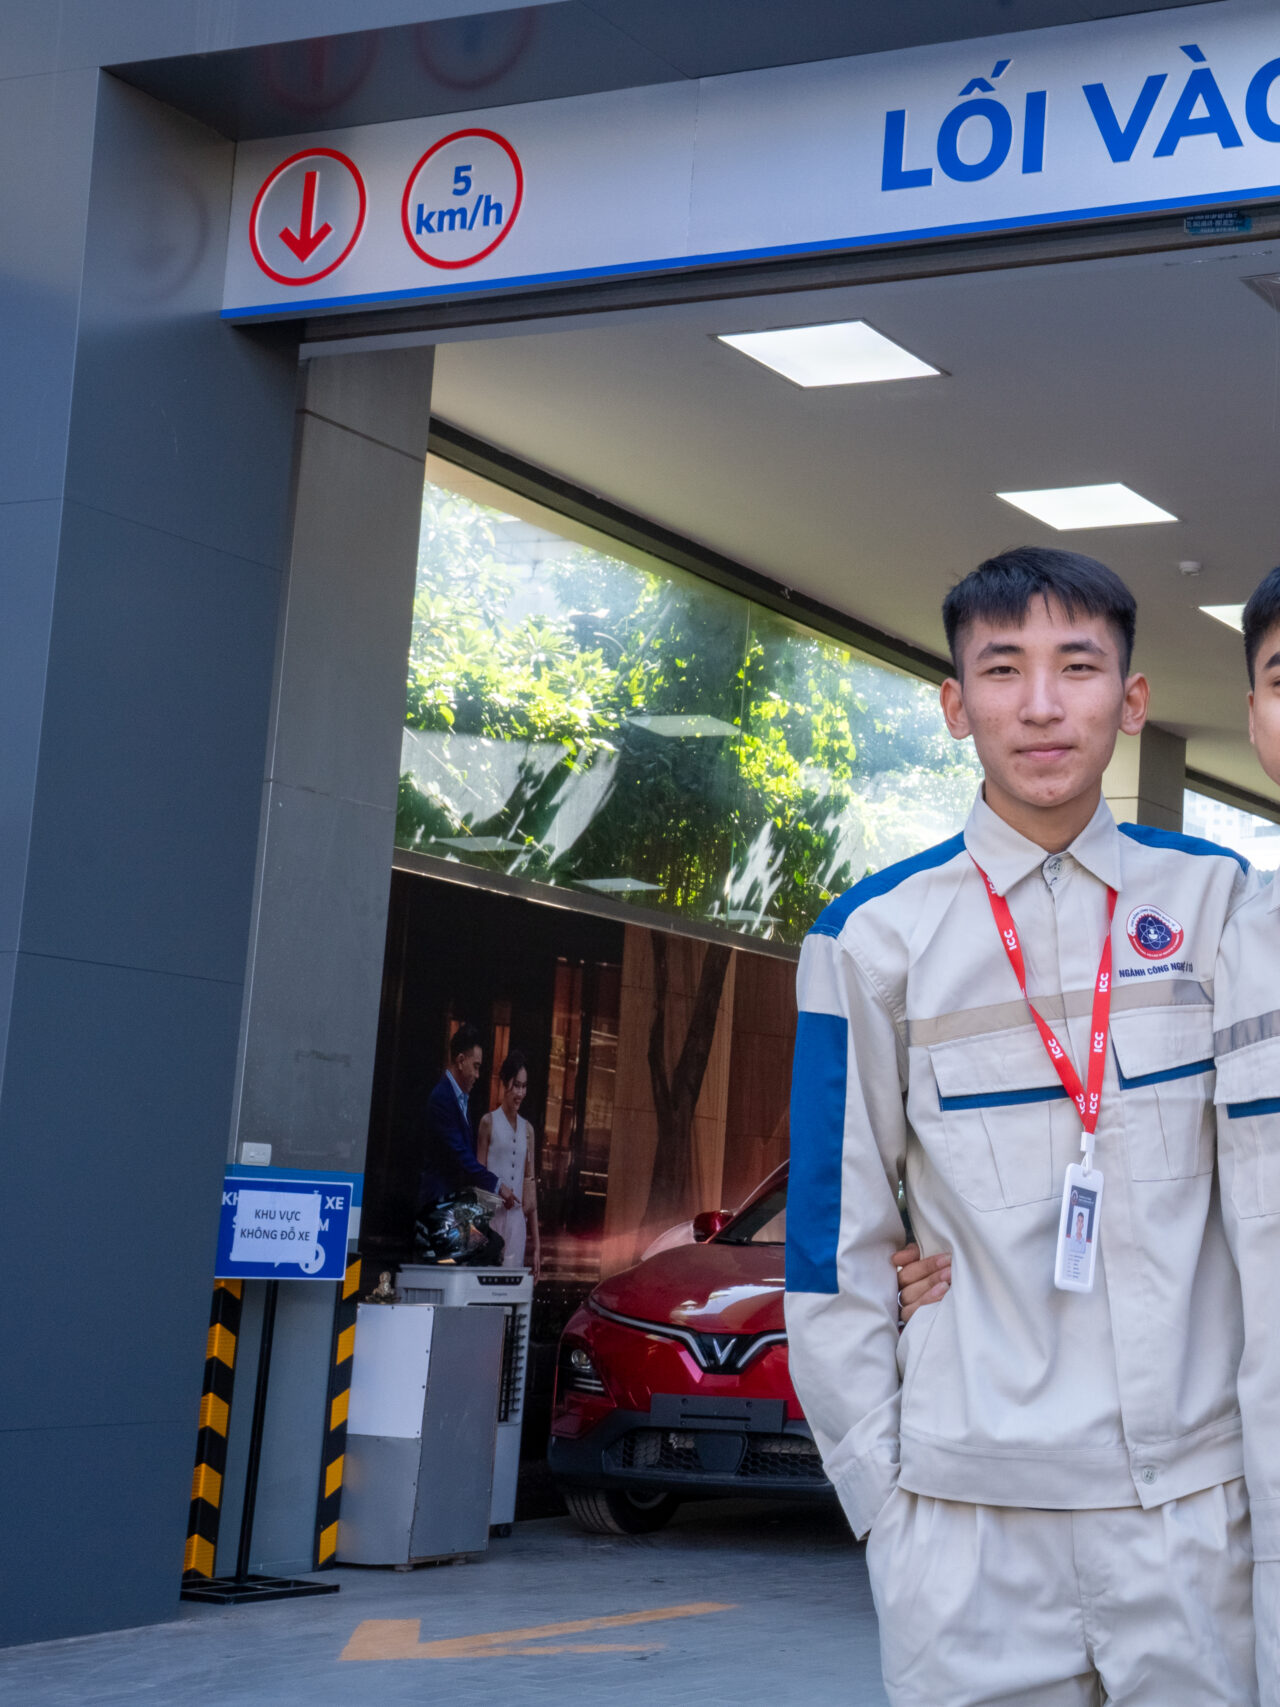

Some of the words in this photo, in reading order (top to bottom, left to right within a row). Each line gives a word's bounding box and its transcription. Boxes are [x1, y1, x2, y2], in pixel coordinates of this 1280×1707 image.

[880, 58, 1047, 192] LỐI
[452, 164, 472, 196] 5
[416, 193, 503, 235] km/h
[1003, 928, 1017, 951] ICC
[1118, 966, 1146, 978] NGÀNH
[1147, 963, 1169, 975] CÔNG
[1099, 972, 1109, 992] ICC
[1048, 1038, 1064, 1059] ICC
[1093, 1032, 1104, 1053] ICC
[1089, 1092, 1099, 1114] ICC
[324, 1196, 344, 1210] XE
[254, 1209, 276, 1221] KHU
[279, 1210, 301, 1223] VỰC
[240, 1227, 278, 1240] KHÔNG
[280, 1227, 296, 1241] ĐỖ
[298, 1231, 310, 1241] XE
